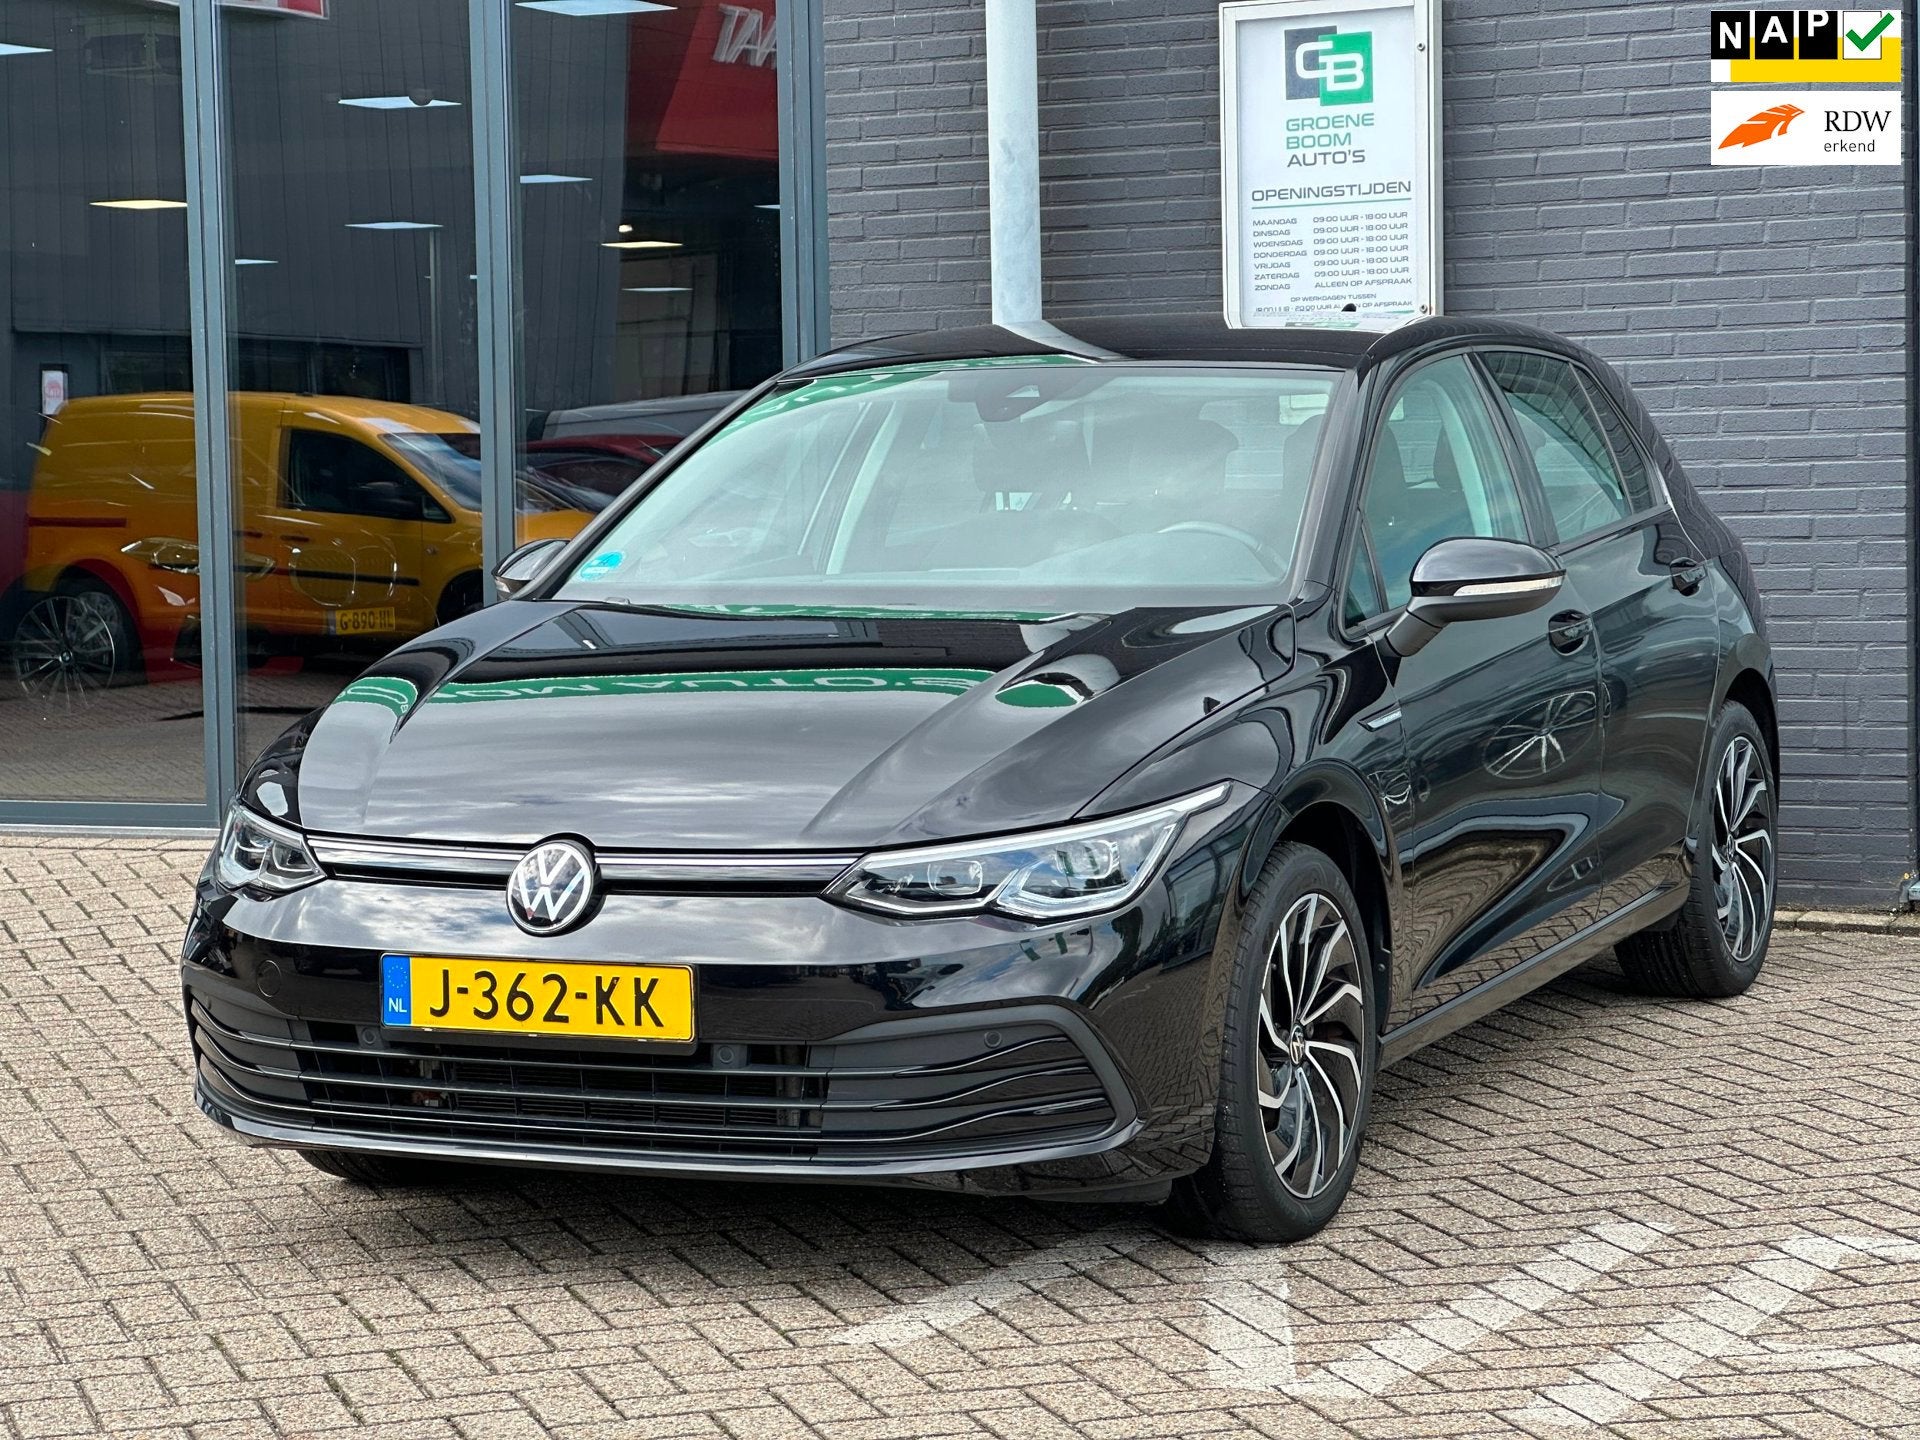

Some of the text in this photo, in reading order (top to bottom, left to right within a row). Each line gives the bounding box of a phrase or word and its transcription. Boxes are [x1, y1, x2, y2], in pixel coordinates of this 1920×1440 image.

[1286, 113, 1375, 132] GROENE
[1286, 133, 1351, 150] BOOM
[1287, 150, 1366, 168] AUTO'S
[1252, 180, 1412, 202] OPENINGSTIJDEN
[1253, 218, 1297, 226] MAANDAG
[1253, 229, 1291, 237] DINSDAG
[1253, 240, 1303, 248] WOENSDAG
[1254, 250, 1307, 259] DONDERDAG
[1254, 272, 1300, 280] ZATERDAG
[1255, 283, 1291, 291] ZONDAG
[1365, 278, 1412, 286] AFSPRAAK
[430, 968, 664, 1028] J-362-KK
[388, 998, 408, 1013] NL
